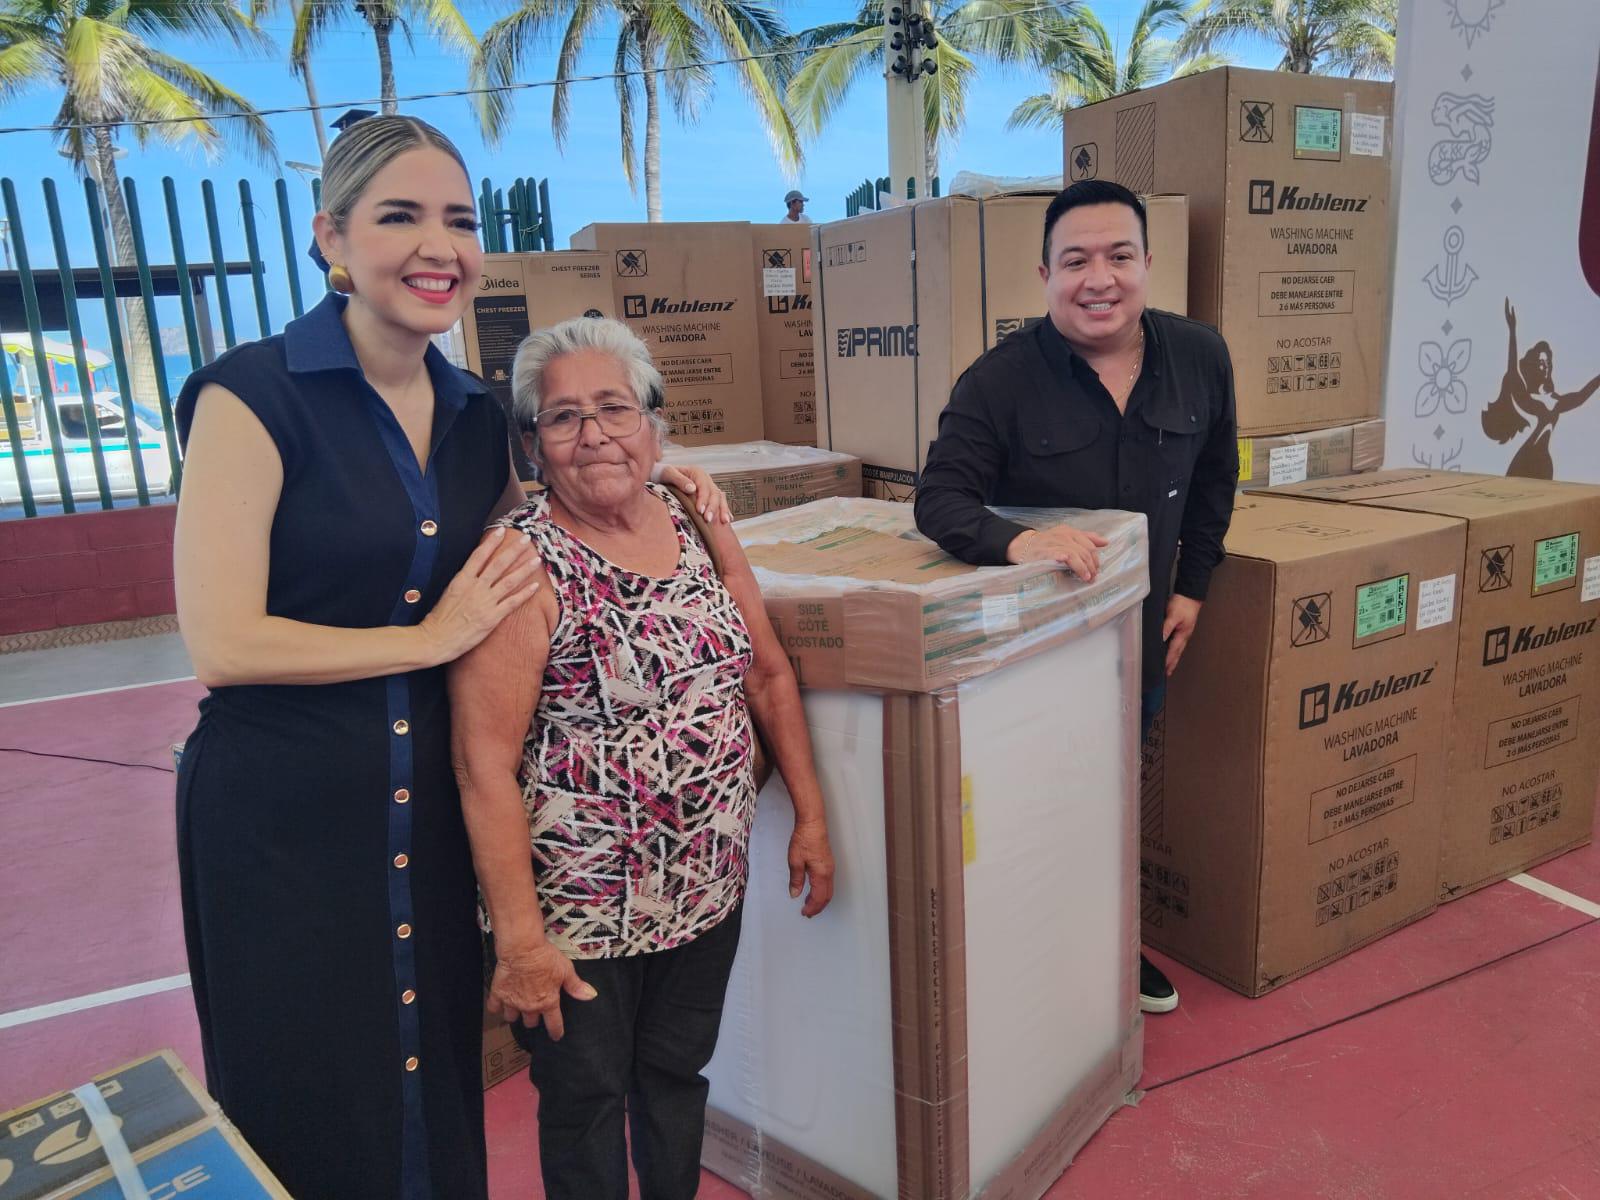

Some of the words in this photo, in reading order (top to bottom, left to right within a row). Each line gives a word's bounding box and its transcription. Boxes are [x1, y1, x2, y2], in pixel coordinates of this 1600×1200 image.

[1277, 186, 1370, 213] Koblenz
[1270, 227, 1314, 240] WASHING
[1315, 228, 1354, 241] MACHINE
[1287, 243, 1338, 255] LAVADORA
[478, 274, 520, 290] Midea
[1281, 276, 1292, 285] NO
[1292, 276, 1318, 284] DEJARSE
[1319, 275, 1335, 284] CAER
[1270, 291, 1288, 299] DEBE
[1288, 290, 1325, 299] MANEJARSE
[1325, 289, 1344, 298] ENTRE
[650, 297, 737, 314] Koblenz
[1304, 301, 1336, 310] PERSONAS
[642, 323, 682, 333] WASHING
[683, 322, 721, 332] MACHINE
[659, 333, 707, 343] LAVADORA
[850, 325, 919, 357] PRIME
[1276, 338, 1291, 350] NO
[1293, 336, 1332, 348] ACOSTAR
[798, 603, 825, 615] SIDE
[787, 636, 844, 649] COSTADO
[1511, 617, 1598, 654] Koblenz
[1502, 664, 1547, 687] WASHING
[1547, 653, 1584, 675] MACHINE
[1332, 666, 1435, 714] Koblenz
[1519, 674, 1568, 698] LAVADORA
[1323, 722, 1374, 751] WASHING
[1374, 707, 1418, 734] MACHINE
[1343, 730, 1399, 762] LAVADORA
[1335, 786, 1347, 799] NO
[1348, 775, 1377, 794] DEJARSE
[1377, 767, 1395, 782] CAER
[1502, 784, 1517, 798] NO
[1519, 769, 1557, 792] ACOSTAR
[1323, 804, 1342, 820] DEBE
[1343, 788, 1383, 812] MANEJARSE
[1360, 796, 1395, 818] PERSONAS
[1328, 857, 1345, 874] NO
[1346, 837, 1390, 864] ACOSTAR
